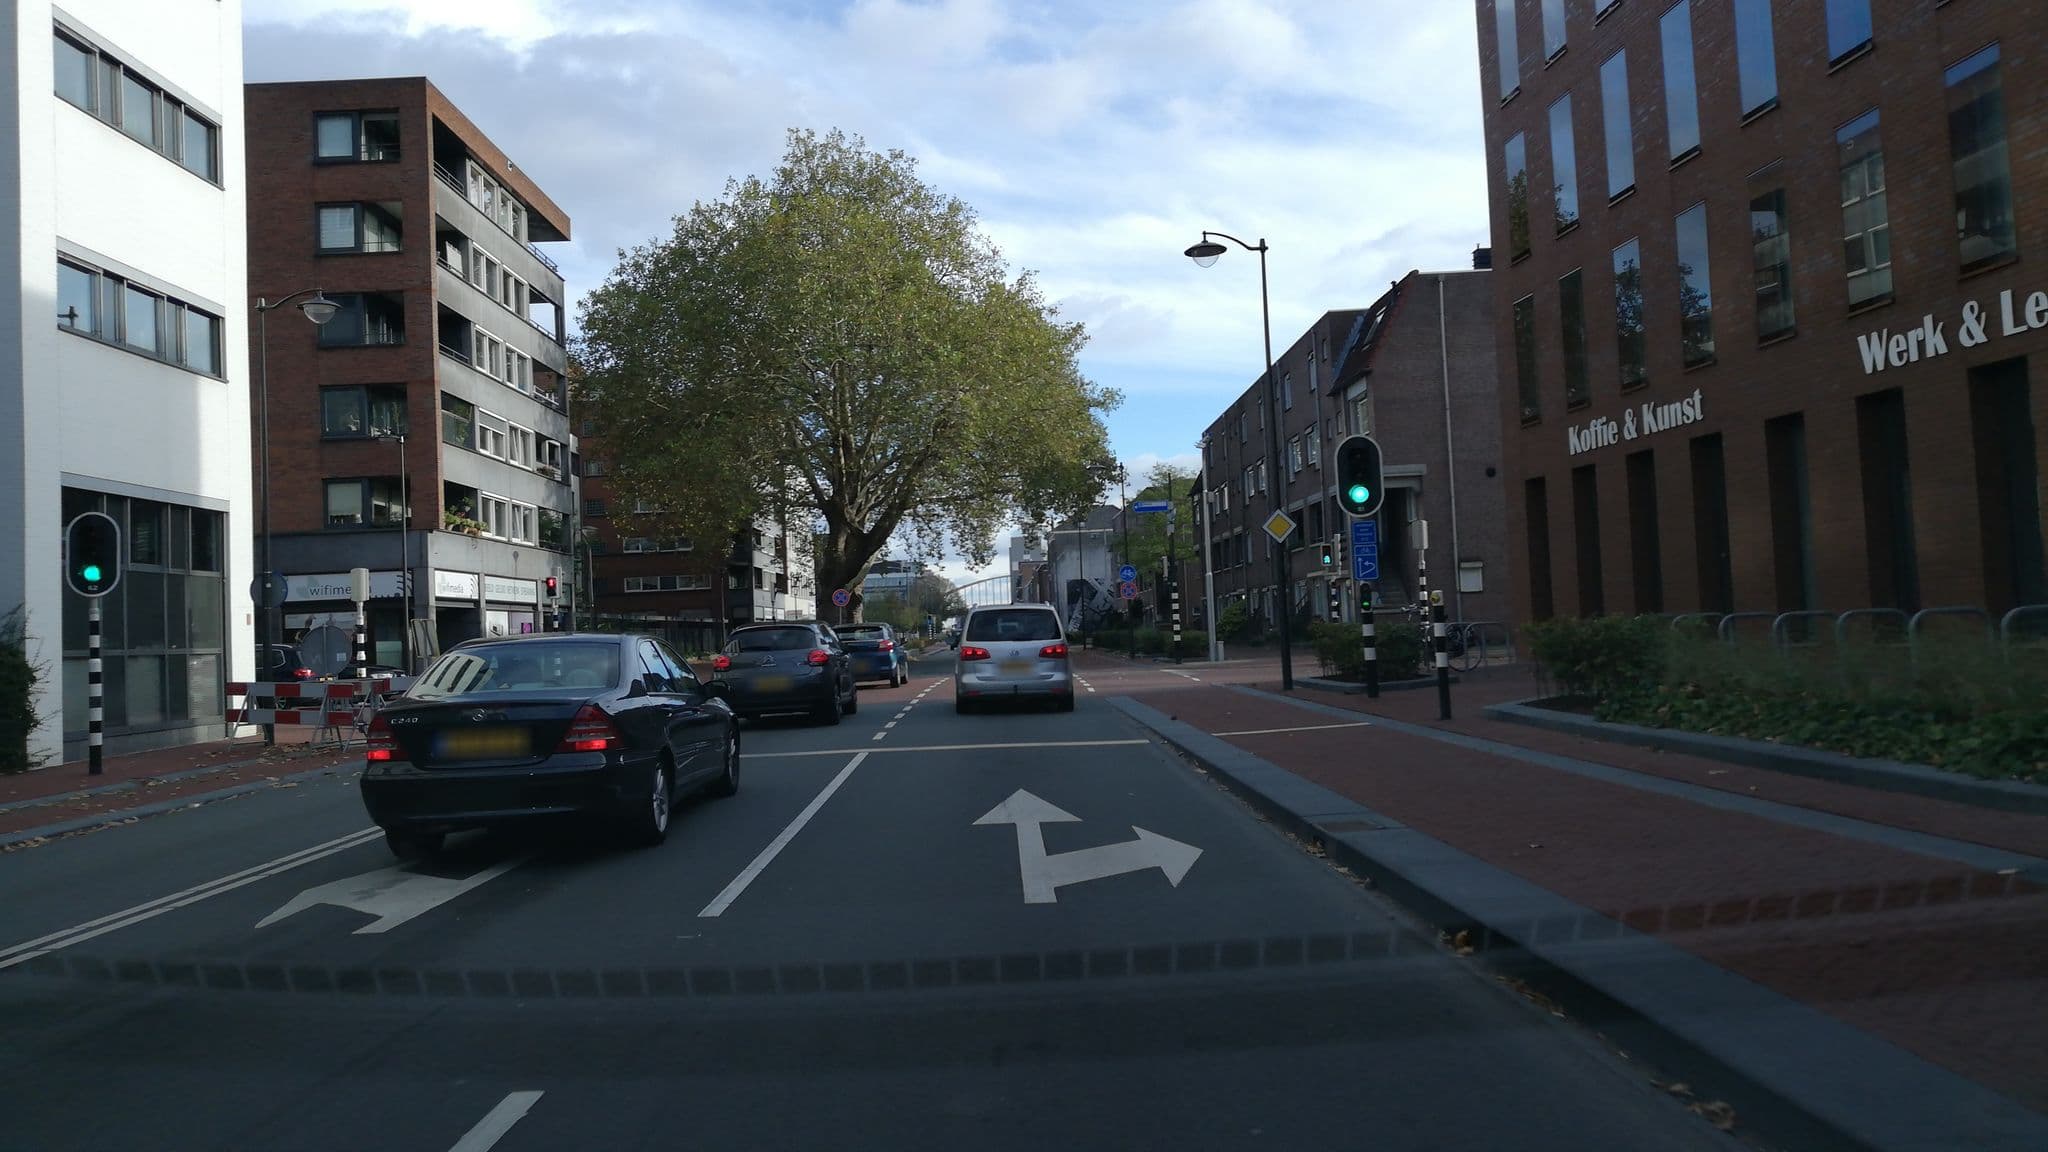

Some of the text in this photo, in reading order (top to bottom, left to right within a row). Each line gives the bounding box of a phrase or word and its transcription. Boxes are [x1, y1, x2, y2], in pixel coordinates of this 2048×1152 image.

[1857, 313, 1949, 375] Werk
[1958, 300, 1989, 348] &
[1568, 388, 1704, 456] Koffie & Kunst
[309, 584, 372, 597] wifime
